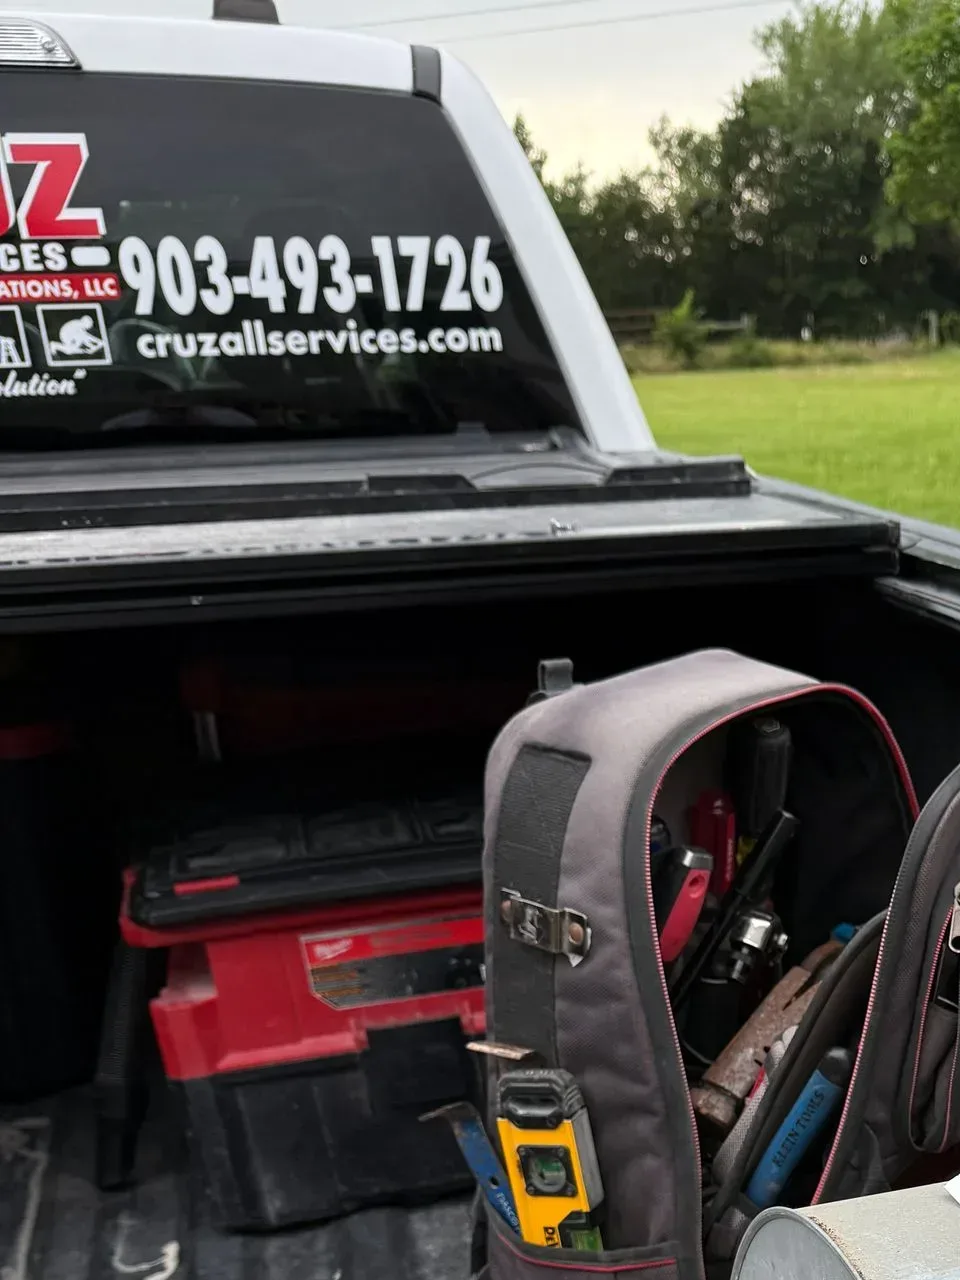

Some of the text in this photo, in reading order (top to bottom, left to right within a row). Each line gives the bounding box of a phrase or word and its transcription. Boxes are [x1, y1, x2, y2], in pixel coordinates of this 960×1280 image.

[83, 278, 118, 297] LLC
[118, 235, 503, 315] 903-493-1726
[137, 320, 502, 358] cruzallservices.com
[772, 1129, 799, 1167] KLEIN
